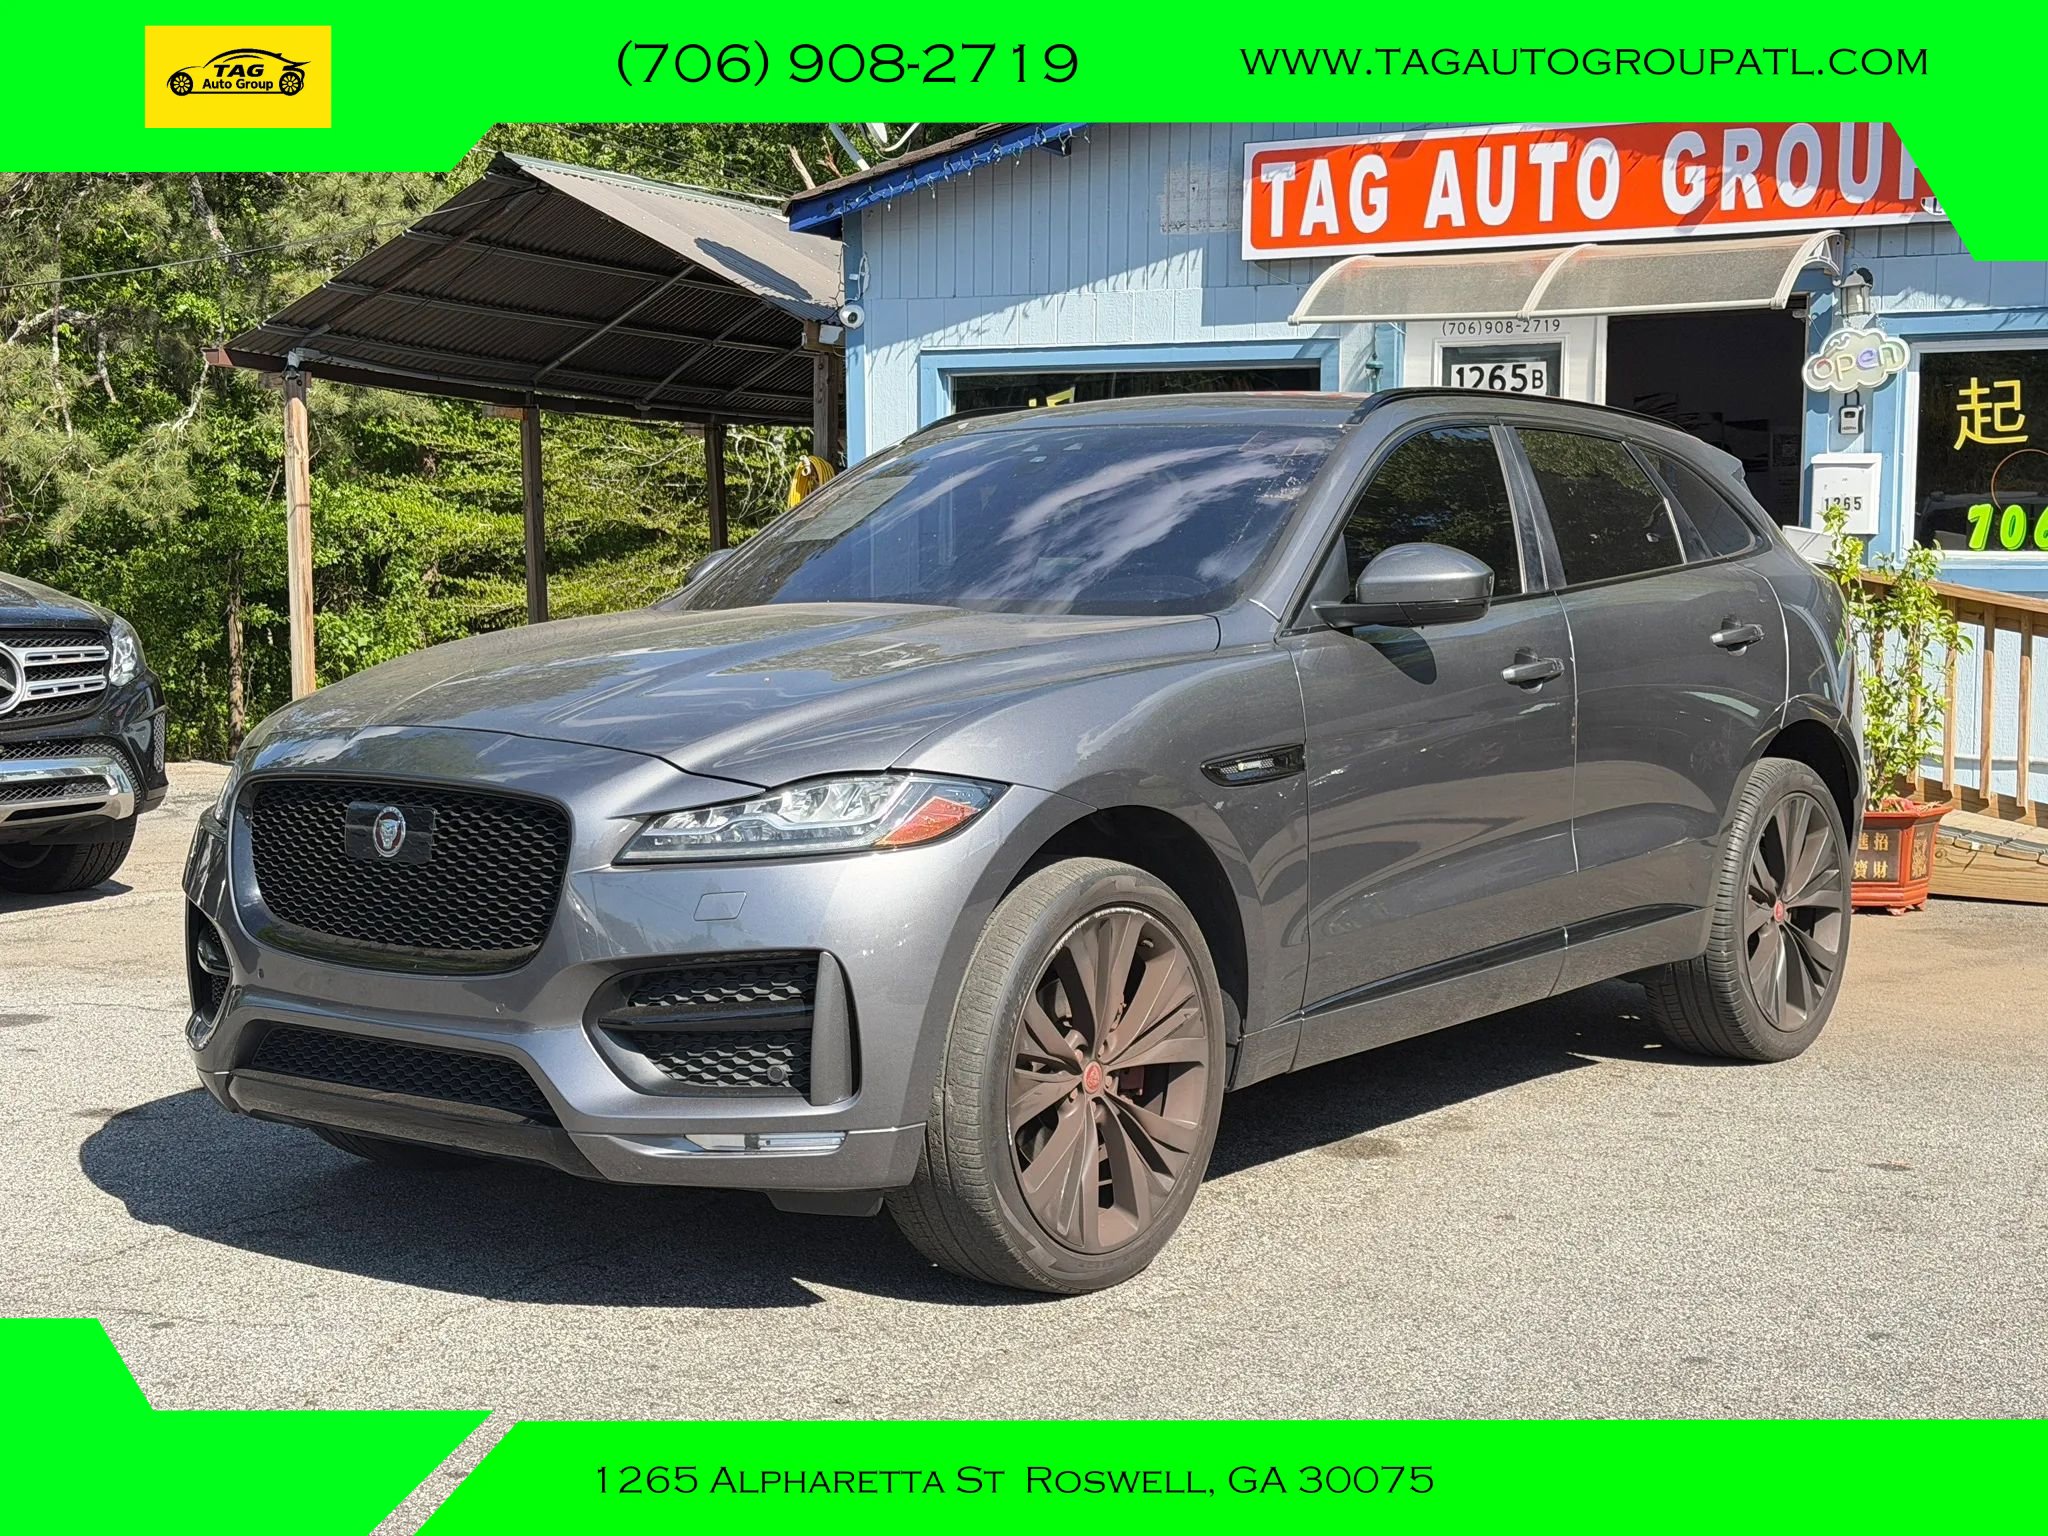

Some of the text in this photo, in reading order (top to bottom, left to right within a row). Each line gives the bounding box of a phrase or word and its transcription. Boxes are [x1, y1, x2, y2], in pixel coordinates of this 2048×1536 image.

[1260, 154, 1389, 238] TAG
[1423, 137, 1621, 230] AUTO
[1441, 319, 1560, 336] (706)908-2719
[1813, 343, 1900, 382] open
[1953, 376, 2029, 451] 起
